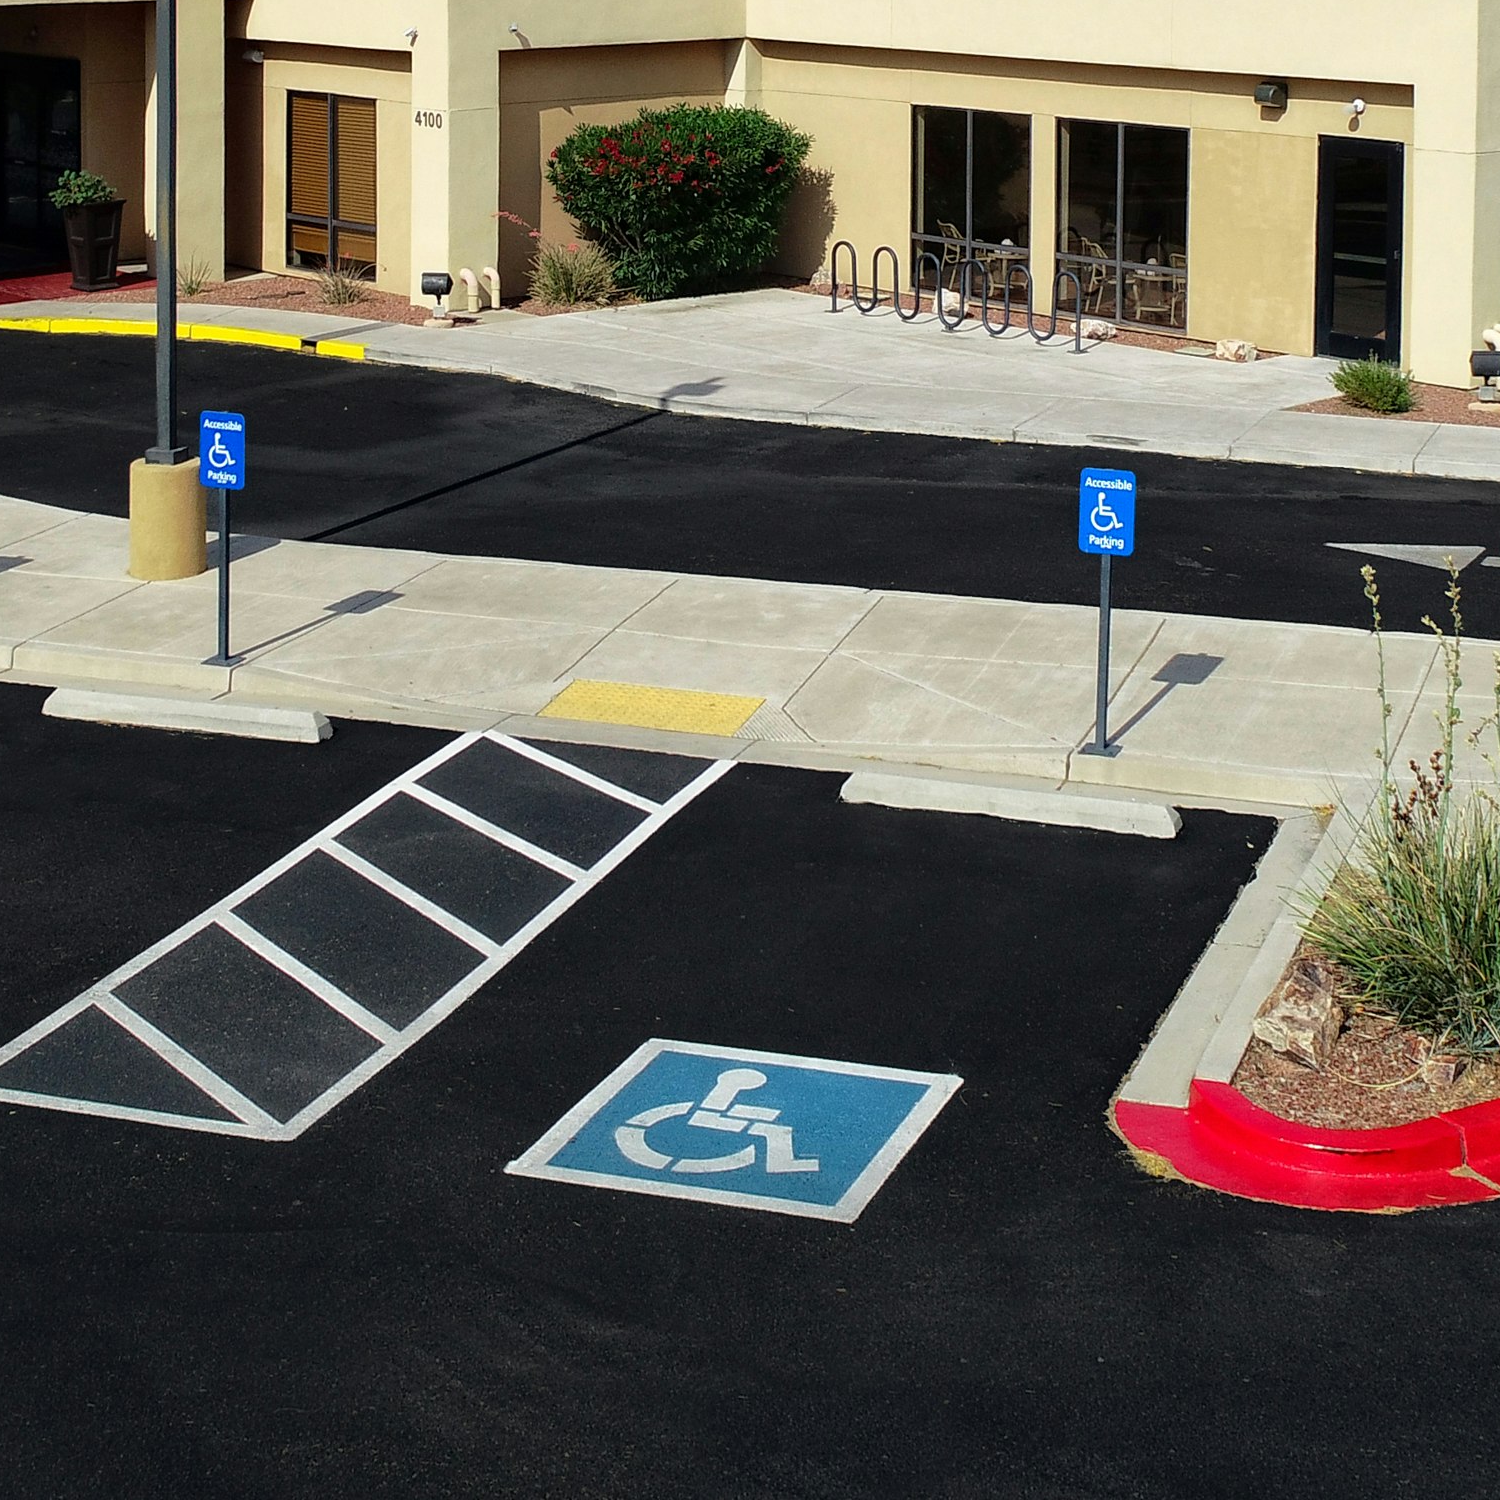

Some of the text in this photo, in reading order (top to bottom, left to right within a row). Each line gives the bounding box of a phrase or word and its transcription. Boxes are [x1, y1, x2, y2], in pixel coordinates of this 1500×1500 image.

[415, 110, 442, 129] 4100
[203, 419, 242, 431] Accessible
[207, 470, 237, 484] Parking
[1084, 477, 1133, 491] Accessible
[1088, 534, 1124, 549] Parking
